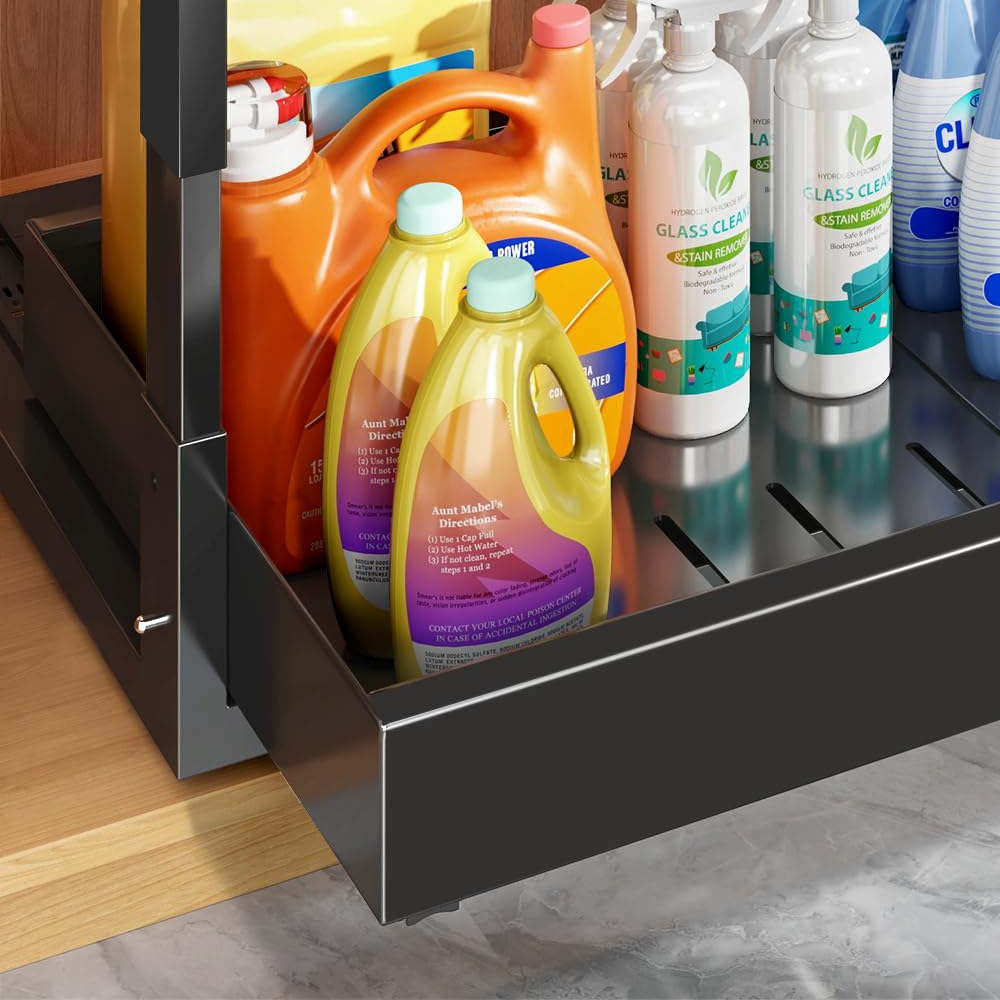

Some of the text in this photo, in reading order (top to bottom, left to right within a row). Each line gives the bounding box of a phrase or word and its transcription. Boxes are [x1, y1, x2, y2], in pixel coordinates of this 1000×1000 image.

[935, 116, 975, 154] CL
[600, 166, 629, 181] GLA
[802, 186, 854, 202] GLASS
[821, 213, 858, 226] &STAIN
[656, 223, 708, 239] GLASS
[844, 231, 858, 240] Safe
[497, 240, 535, 258] POWER
[830, 237, 874, 250] Biodegradable
[673, 249, 713, 263] &STAIN
[697, 268, 713, 277] Safe
[684, 274, 728, 288] Biodegradable
[588, 373, 611, 388] ATED
[361, 419, 387, 429] Aunt
[357, 447, 368, 456] (1)
[369, 447, 383, 455] Use
[357, 456, 399, 466] (2) Use Ho
[358, 467, 369, 476] (3)
[369, 478, 390, 486] steps
[431, 500, 504, 516] Aunt Mabel's
[439, 514, 497, 528] Directions
[427, 535, 438, 544] (1)
[439, 535, 454, 543] Use
[461, 534, 477, 544] Cap
[479, 530, 495, 540] Full
[427, 541, 499, 554] (2) Use Hot Water
[428, 547, 513, 565] (3) If not clean, repeat
[440, 566, 461, 575] steps
[468, 563, 484, 572] and
[428, 587, 582, 633] CONTACT YOUR LOCAL POISON CENTER
[436, 634, 445, 642] IN
[447, 634, 470, 642] CASE
[485, 619, 538, 640] ACCIDENTAL
[539, 600, 577, 624] INGESTION
